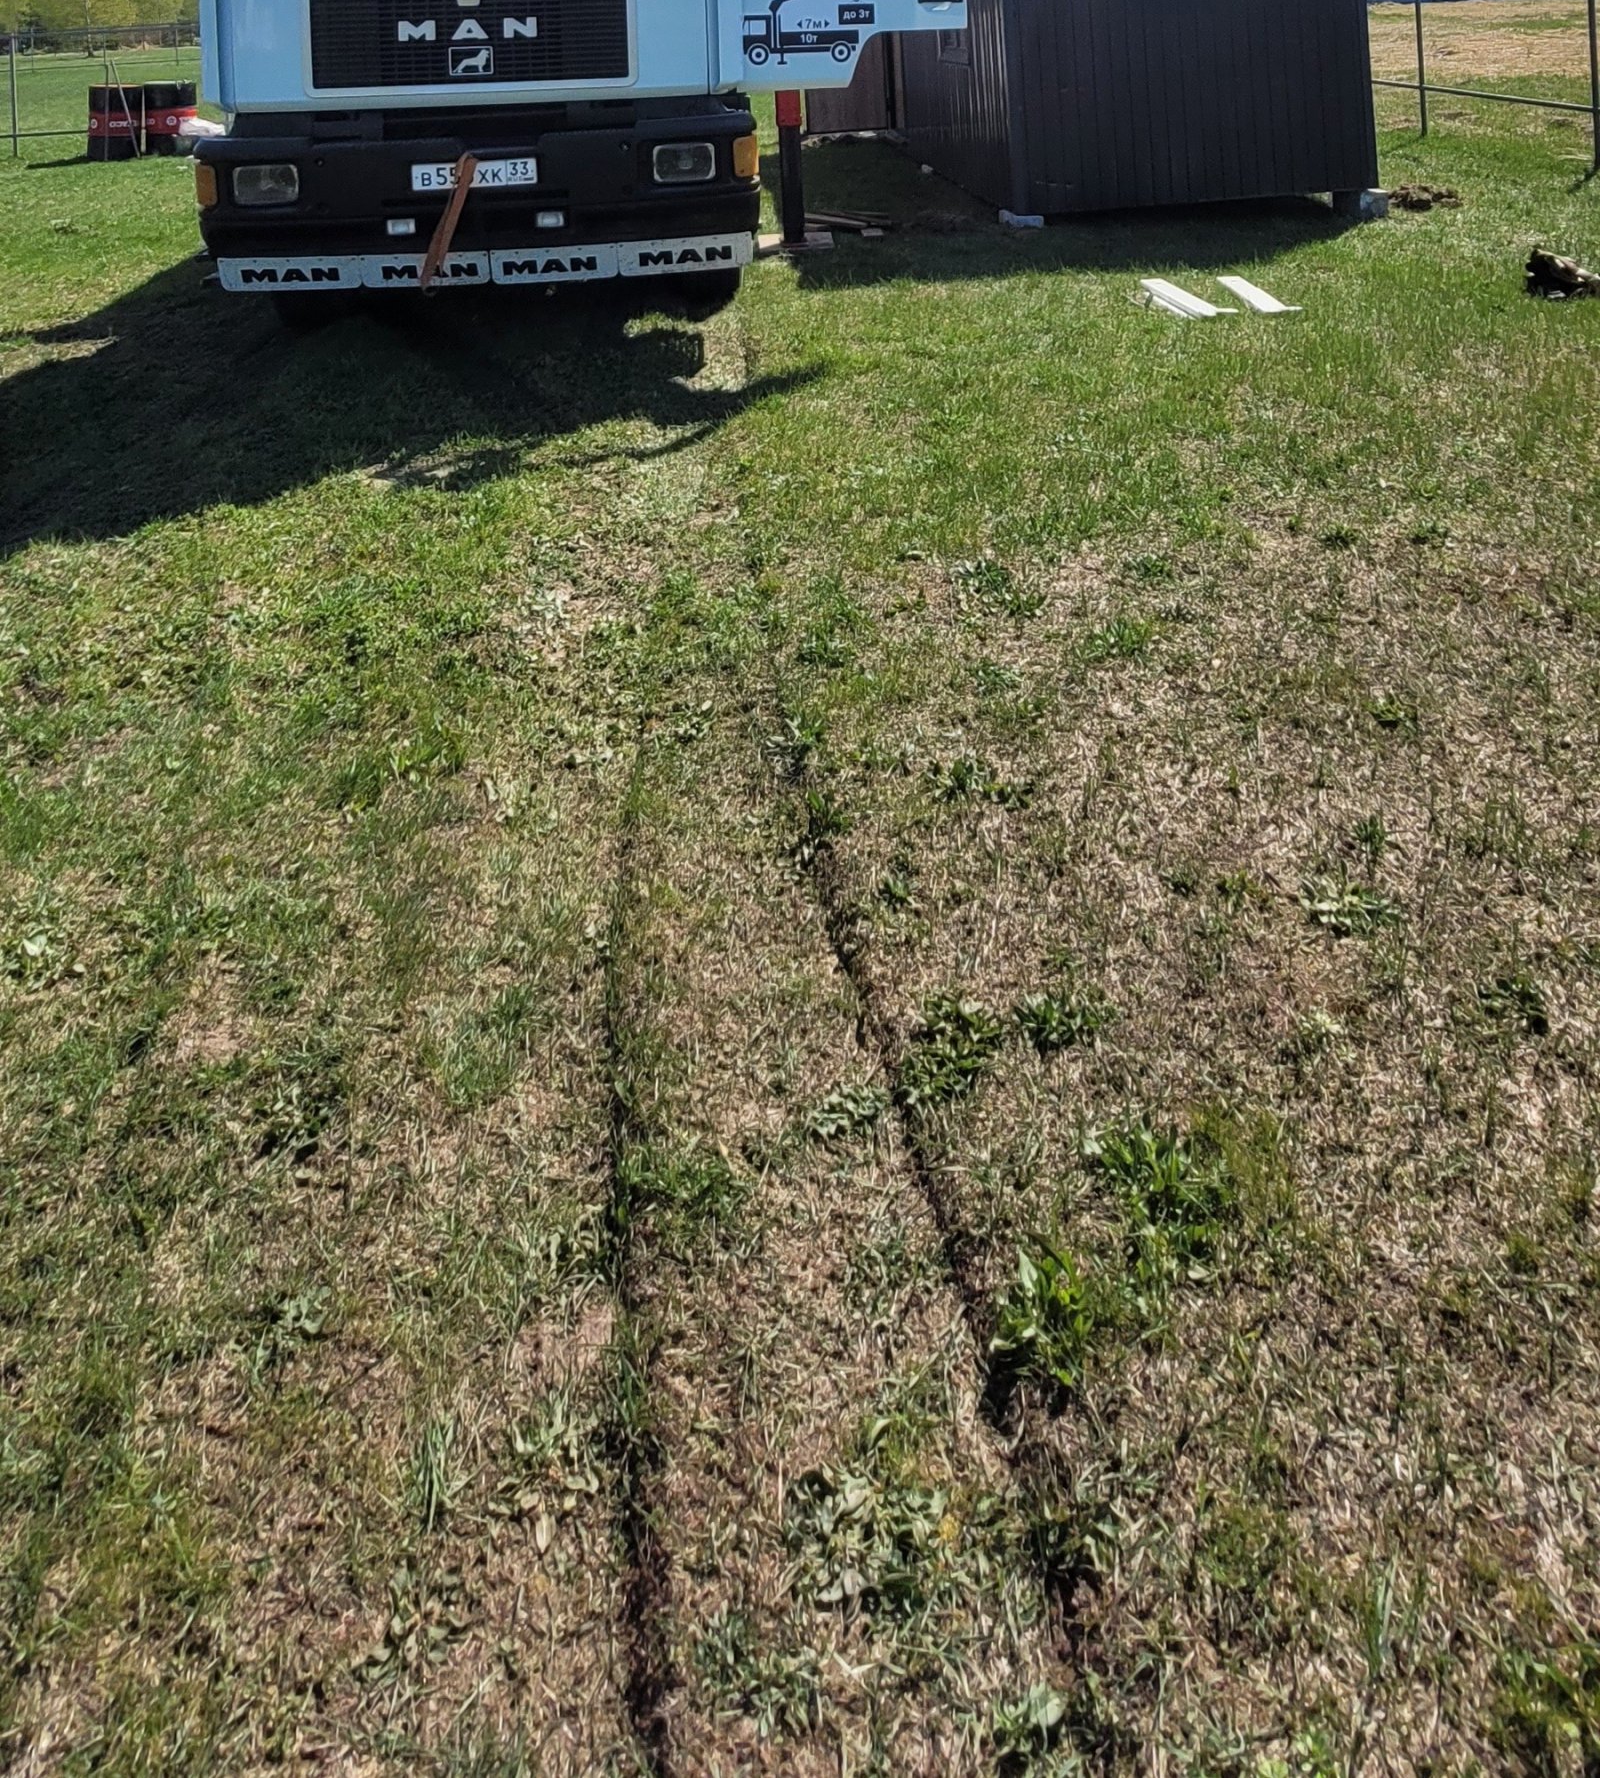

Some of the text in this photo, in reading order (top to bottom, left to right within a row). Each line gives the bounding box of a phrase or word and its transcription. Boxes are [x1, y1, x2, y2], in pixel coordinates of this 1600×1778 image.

[843, 9, 871, 21] до 3т
[398, 16, 538, 42] MAN
[805, 18, 822, 30] 7м
[800, 33, 818, 43] 10т
[510, 161, 530, 177] 33
[639, 245, 732, 267] MAN
[502, 256, 598, 276] MAN
[240, 267, 340, 284] MAN
